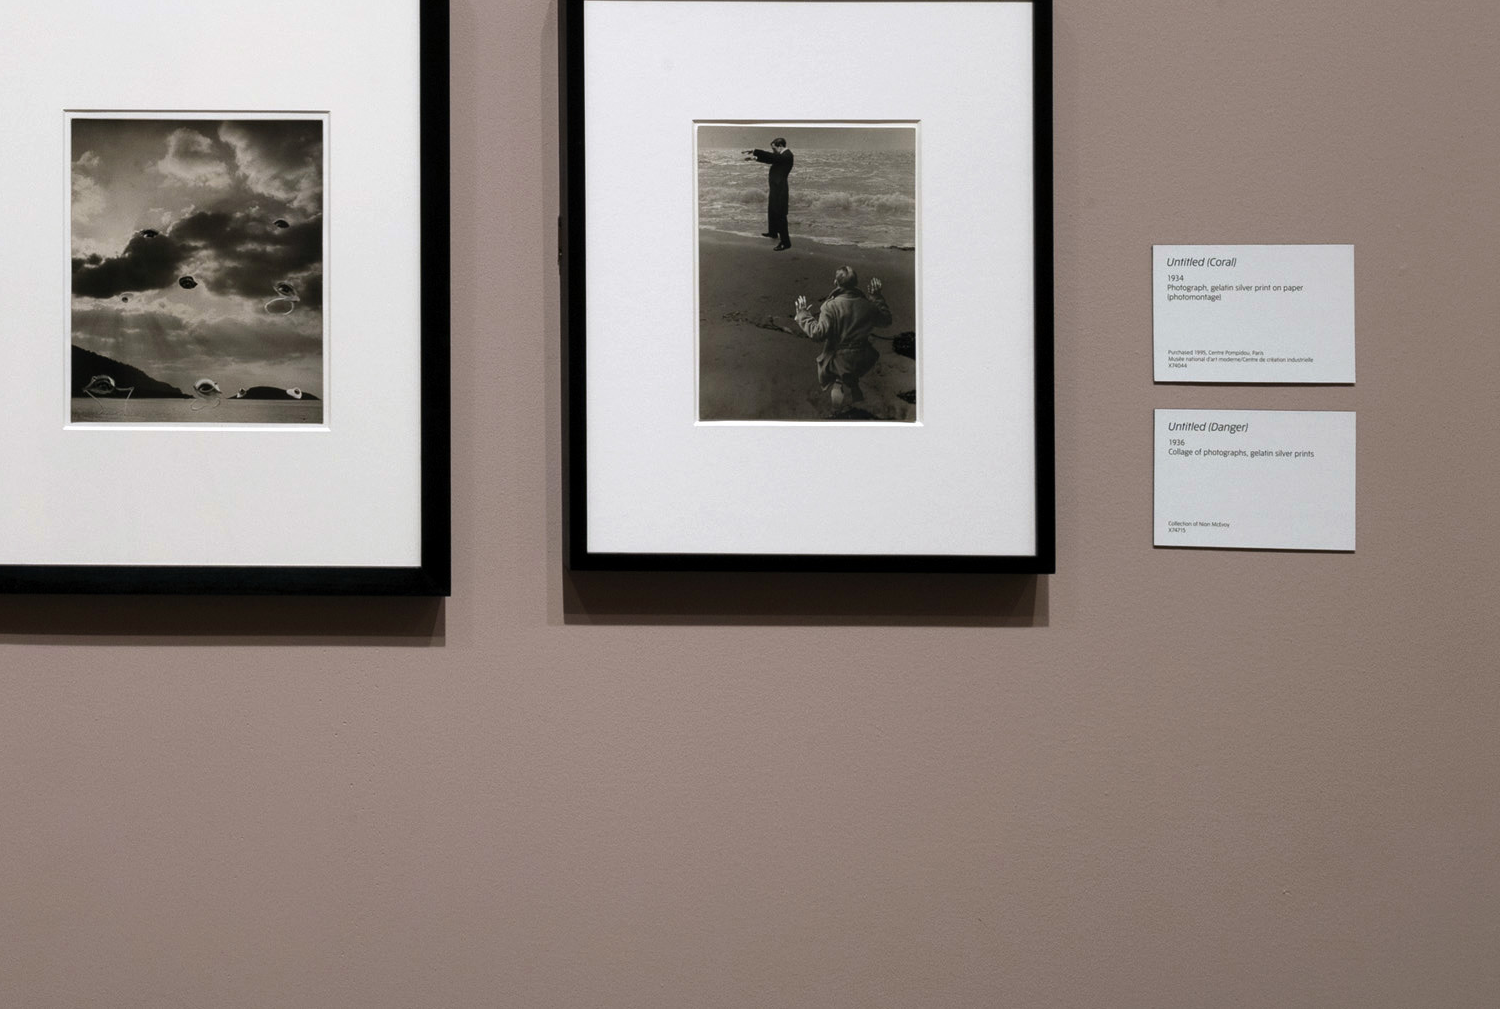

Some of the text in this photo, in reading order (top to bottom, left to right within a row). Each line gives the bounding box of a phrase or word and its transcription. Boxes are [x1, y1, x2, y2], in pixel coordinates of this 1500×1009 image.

[1166, 258, 1237, 267] Untitled (Coral)
[1167, 284, 1209, 293] Photograph,
[1210, 284, 1234, 293] gelatin
[1235, 284, 1253, 292] silver
[1167, 294, 1222, 302] (photomontage)
[1168, 422, 1249, 434] Untitled (Danger)
[1168, 448, 1193, 457] Collage
[1194, 448, 1202, 456] of
[1203, 449, 1249, 458] photographs,
[1250, 450, 1274, 458] gelatin
[1294, 451, 1315, 459] prints
